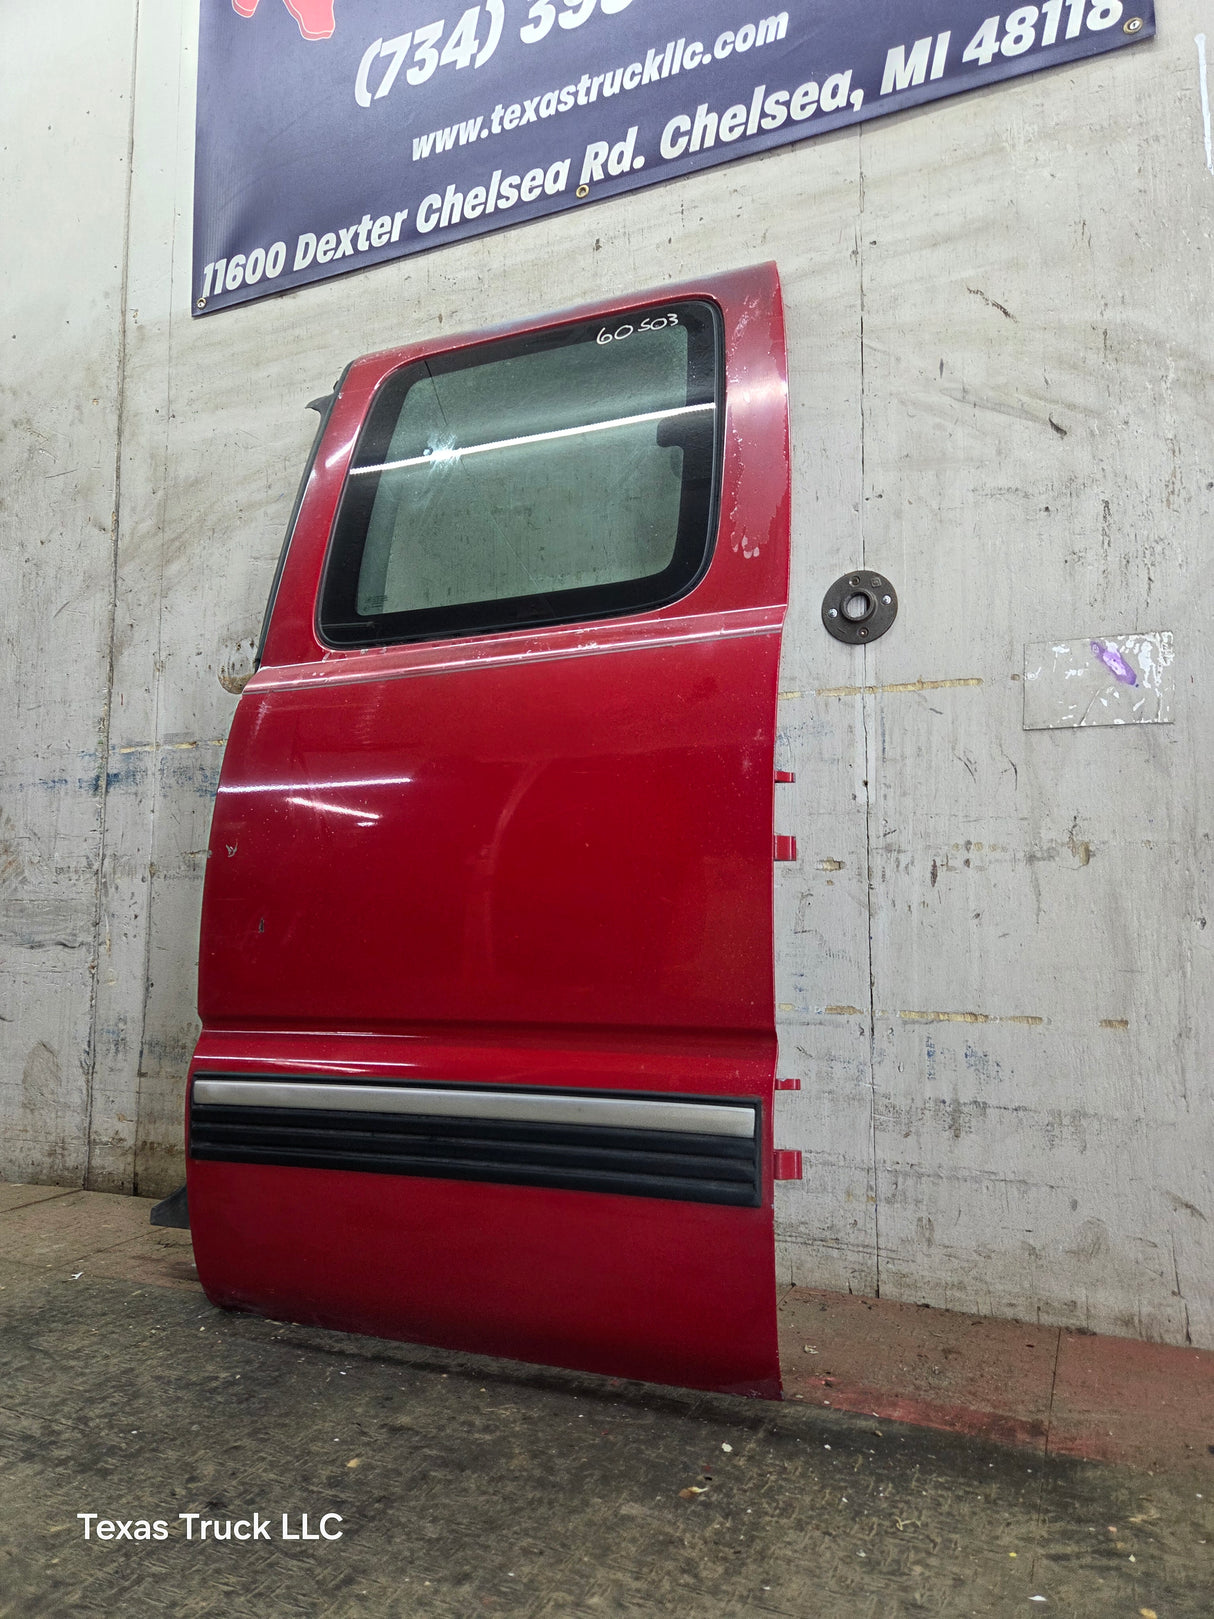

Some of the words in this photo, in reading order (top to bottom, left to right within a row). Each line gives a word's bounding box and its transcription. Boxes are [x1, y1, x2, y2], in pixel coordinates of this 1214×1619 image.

[354, 0, 505, 107] (734)
[412, 11, 789, 161] www.texastruckllc.com
[202, 241, 286, 297] 11600
[293, 208, 408, 271] Dexter
[415, 158, 571, 234] Chelsea
[579, 125, 646, 186] Rd.
[660, 69, 865, 160] Chelsea,
[879, 30, 952, 95] MI
[962, 0, 1124, 66] 48118
